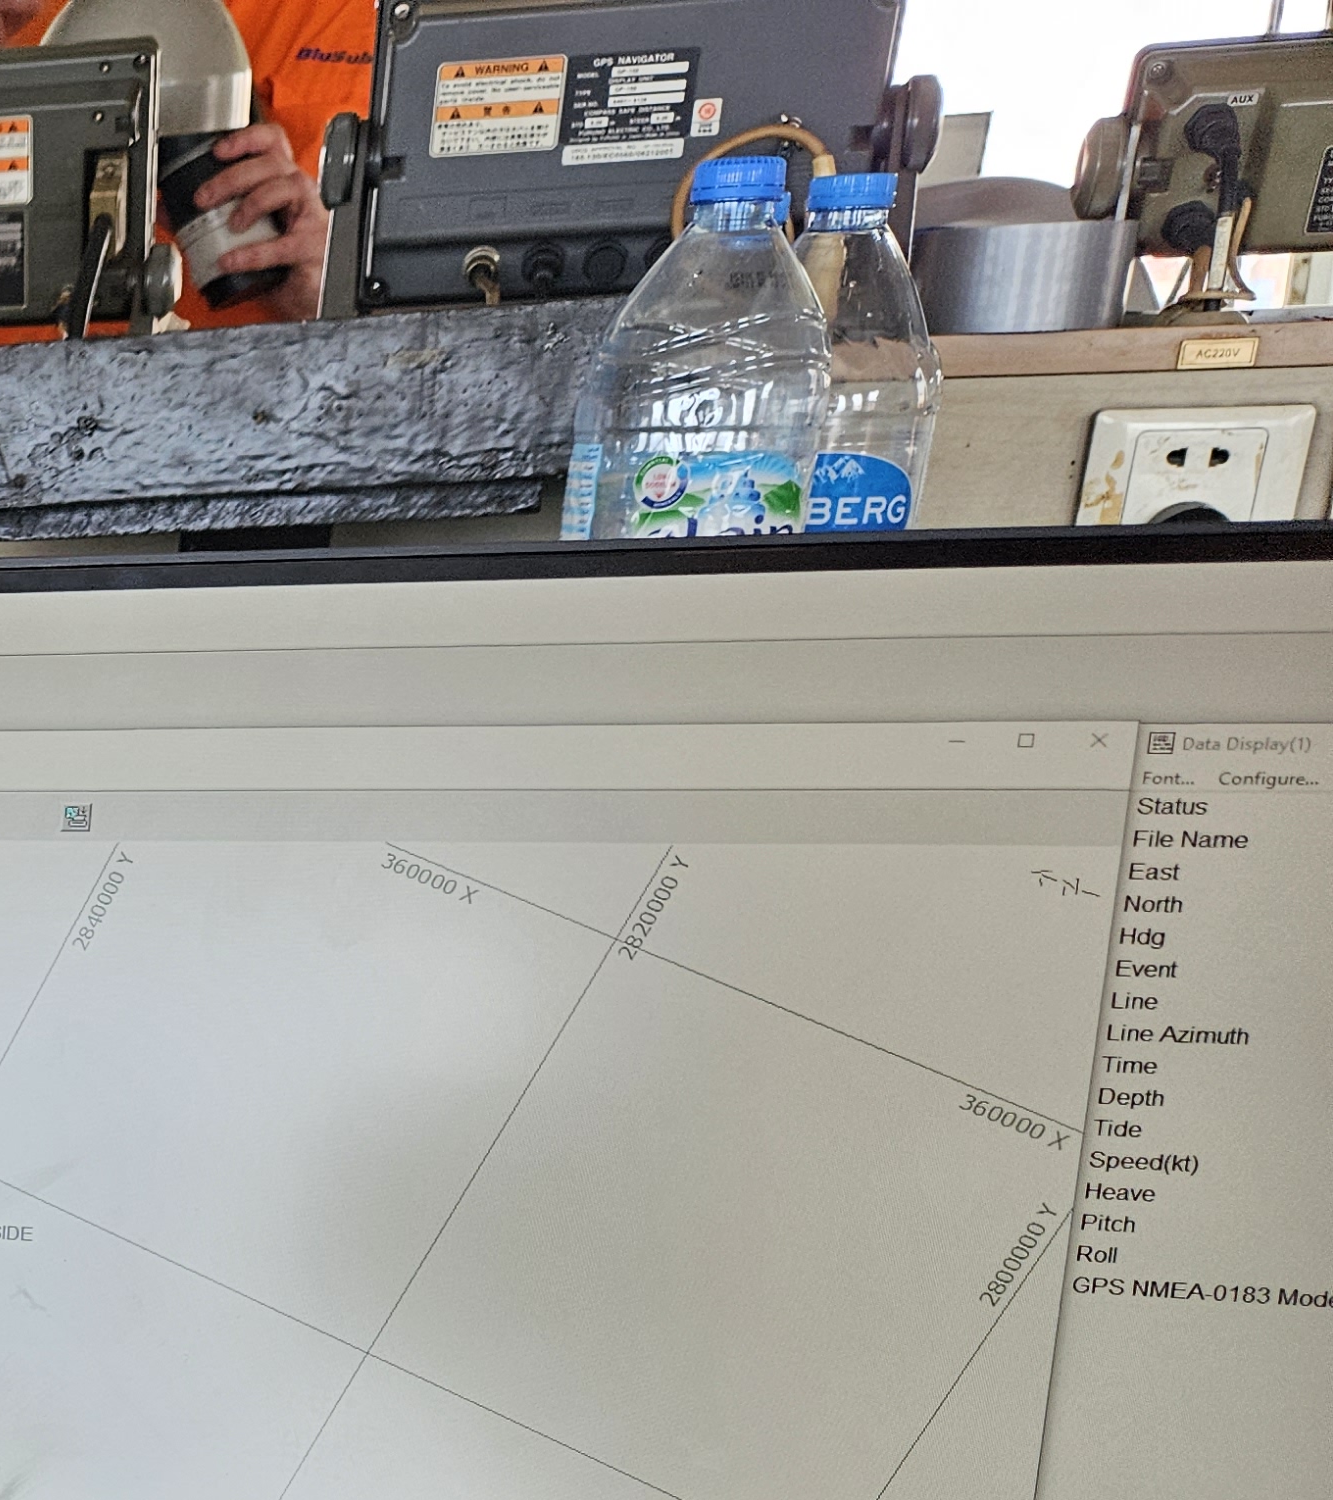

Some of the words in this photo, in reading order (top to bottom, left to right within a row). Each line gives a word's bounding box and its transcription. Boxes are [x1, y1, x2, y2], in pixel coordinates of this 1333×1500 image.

[474, 62, 530, 76] WARNING
[593, 57, 614, 68] GPS
[618, 53, 675, 65] NAVIGATOR
[1231, 95, 1254, 104] AUX
[1195, 348, 1240, 359] AC220V
[808, 495, 907, 525] BERG
[1183, 737, 1221, 751] Data
[1226, 737, 1311, 754] Display(1)
[1218, 771, 1319, 789] Configure...
[1137, 797, 1209, 815] Status
[1132, 829, 1174, 848] File
[1181, 830, 1249, 849] Name
[381, 853, 458, 896] 360000
[459, 884, 481, 905] X
[1128, 862, 1180, 881] East
[72, 870, 126, 951] 2840000
[115, 851, 135, 869] Y
[618, 874, 680, 961] 2820000
[671, 854, 691, 872] Y
[1123, 895, 1183, 913] North
[1119, 927, 1166, 949] Hdg
[1115, 960, 1178, 979] Event
[1111, 991, 1159, 1010] Line
[1107, 1024, 1154, 1042] Line
[1159, 1025, 1250, 1045] Azimuth
[1102, 1055, 1158, 1075] Time
[1098, 1087, 1165, 1109] Depth
[958, 1093, 1047, 1141] 360000
[1047, 1130, 1072, 1151] X
[1093, 1118, 1142, 1138] Tide
[1089, 1150, 1199, 1176] Speed(kt)
[1084, 1182, 1156, 1202] Heave
[1080, 1213, 1135, 1233] Pitch
[980, 1219, 1047, 1307] 2800000
[1037, 1201, 1059, 1221] Y
[1076, 1244, 1118, 1264] Roll
[1072, 1276, 1125, 1296] GPS
[1132, 1279, 1271, 1305] NMEA-0183
